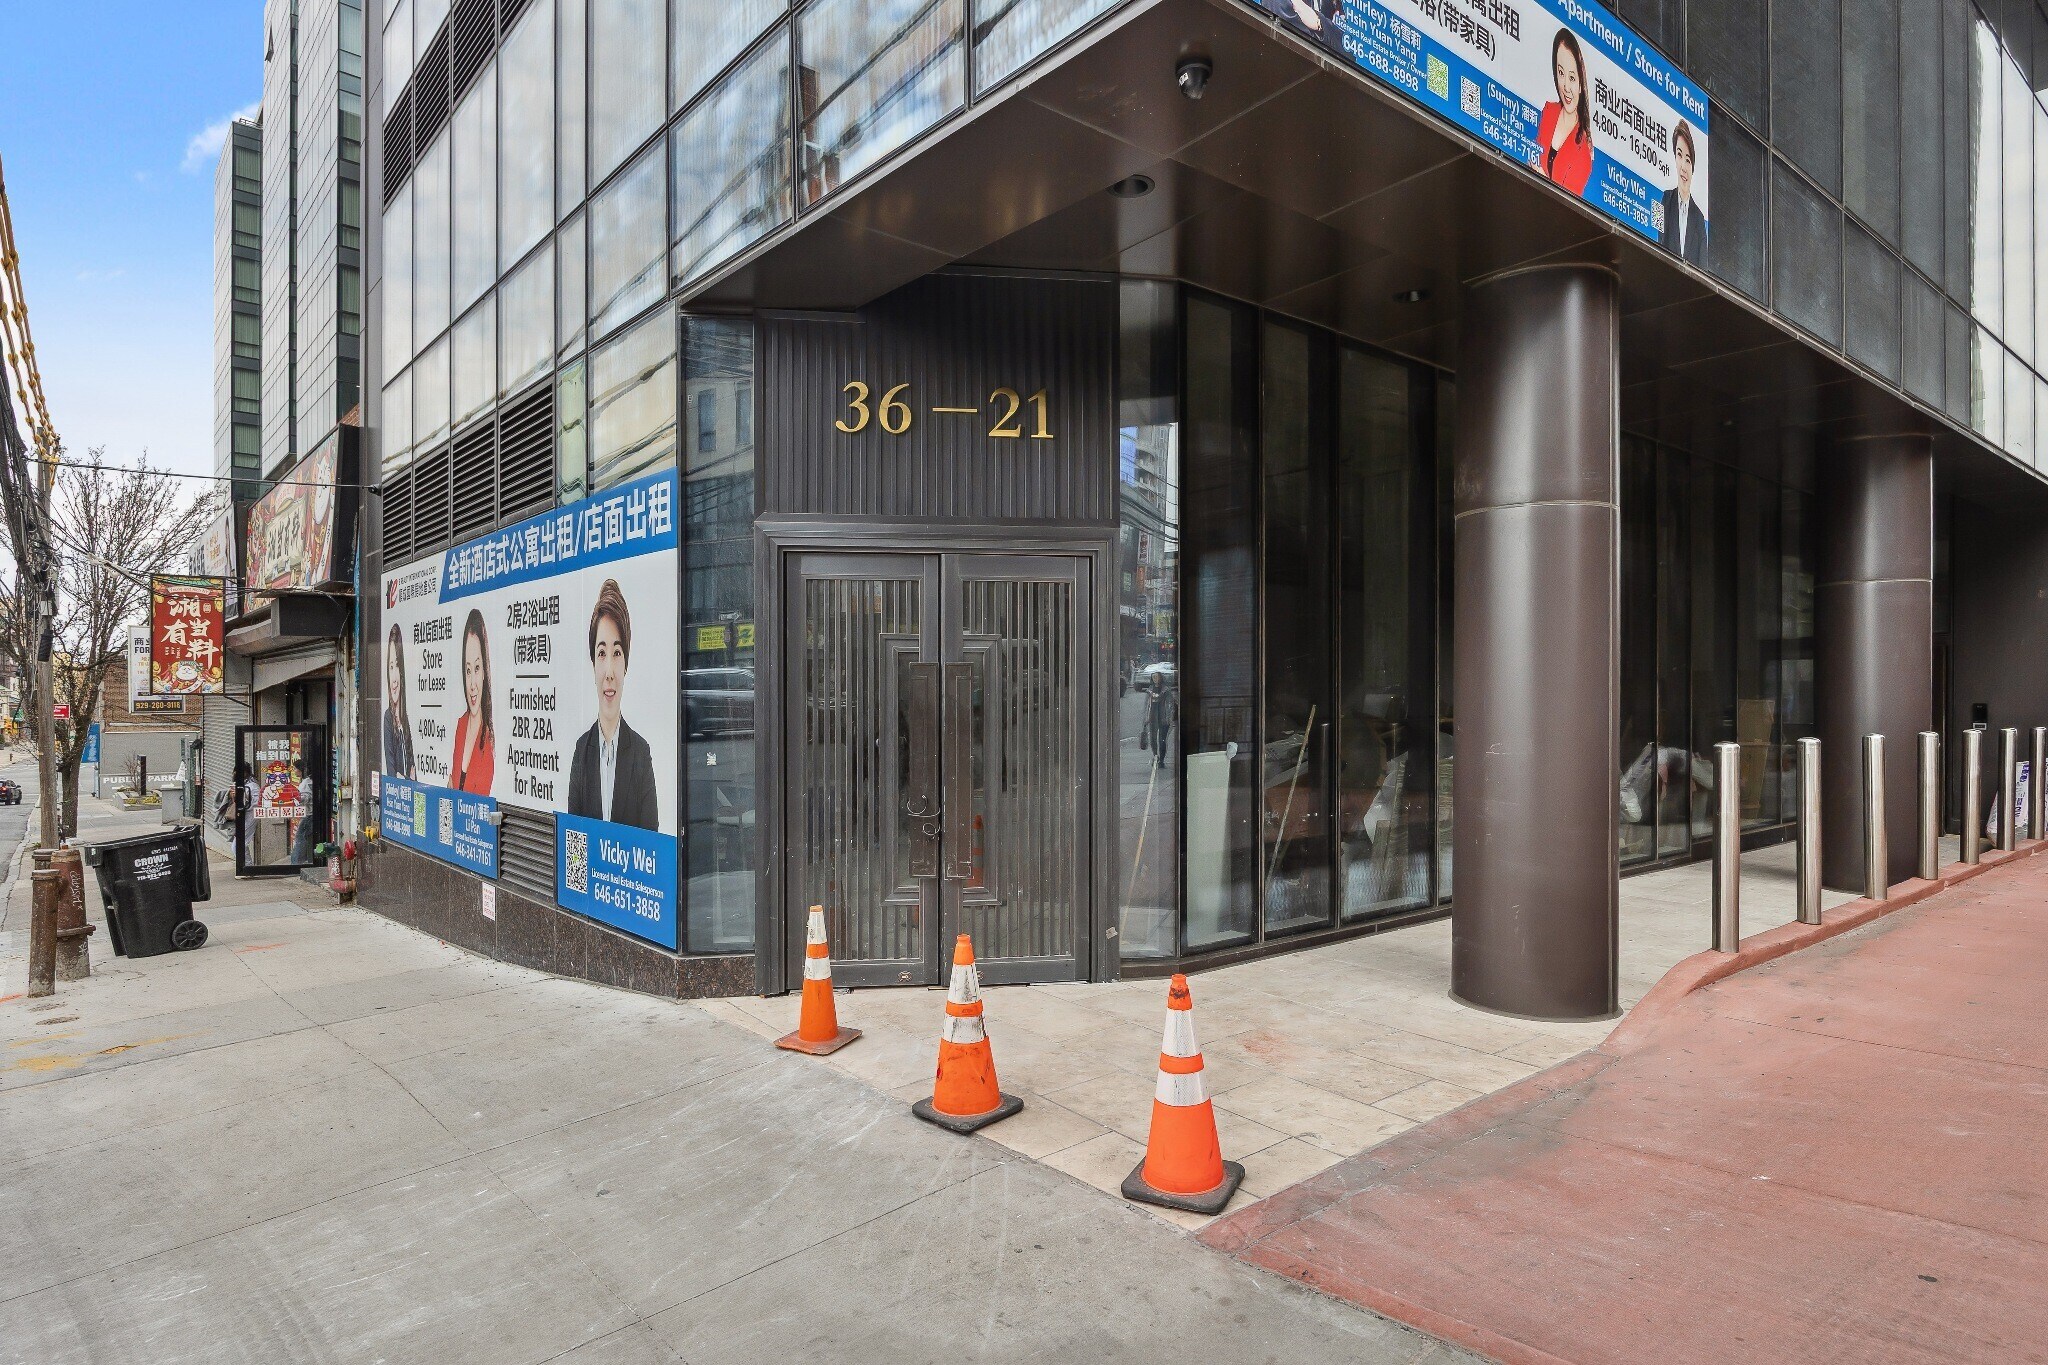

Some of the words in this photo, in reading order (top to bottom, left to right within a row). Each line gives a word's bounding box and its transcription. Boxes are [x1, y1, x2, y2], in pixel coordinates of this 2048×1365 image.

[1335, 15, 1359, 37] Licensed
[1360, 32, 1371, 45] Real
[1373, 40, 1389, 56] Estate
[1346, 7, 1367, 31] Hsin
[1370, 22, 1393, 47] Yuan
[1395, 38, 1417, 65] Yang
[1343, 34, 1419, 92] 646-688-8998
[1487, 82, 1519, 116] (Sunny)
[1634, 48, 1663, 86] Store
[1665, 73, 1681, 100] for
[1682, 86, 1705, 120] Rent
[1481, 108, 1498, 125] Licensed
[1501, 107, 1508, 123] Li
[1510, 114, 1524, 132] Pan
[1595, 78, 1667, 153] 商业店面出租
[1483, 120, 1540, 166] 646-341-7161
[1593, 110, 1618, 140] 4,800
[1630, 135, 1658, 167] 16,500
[1607, 163, 1629, 193] Vicky
[1631, 179, 1646, 200] Wei
[1603, 191, 1649, 227] 646-651-3858
[507, 595, 560, 628] 2房2浴出租
[423, 649, 443, 670] Store
[513, 634, 551, 665] (带家具)
[418, 673, 427, 691] for
[429, 674, 446, 691] Lease
[510, 687, 556, 711] Furnished
[418, 719, 436, 739] 4,800
[512, 715, 530, 739] 2BR
[533, 718, 554, 741] 2BA
[417, 754, 437, 775] 16,500
[507, 744, 559, 772] Apartment
[514, 771, 528, 795] for
[530, 775, 554, 801] Rent
[458, 799, 477, 819] (Sunny)
[465, 818, 471, 831] Li
[471, 821, 481, 835] Pan
[134, 853, 169, 868] CROWN
[455, 840, 492, 867] 646-341-7161
[599, 838, 630, 873] Vicky
[632, 845, 656, 876] Wei
[591, 867, 609, 882] Licensed
[620, 876, 635, 889] Estate
[635, 880, 664, 900] Salesperson
[594, 882, 661, 922] 646-651-3858
